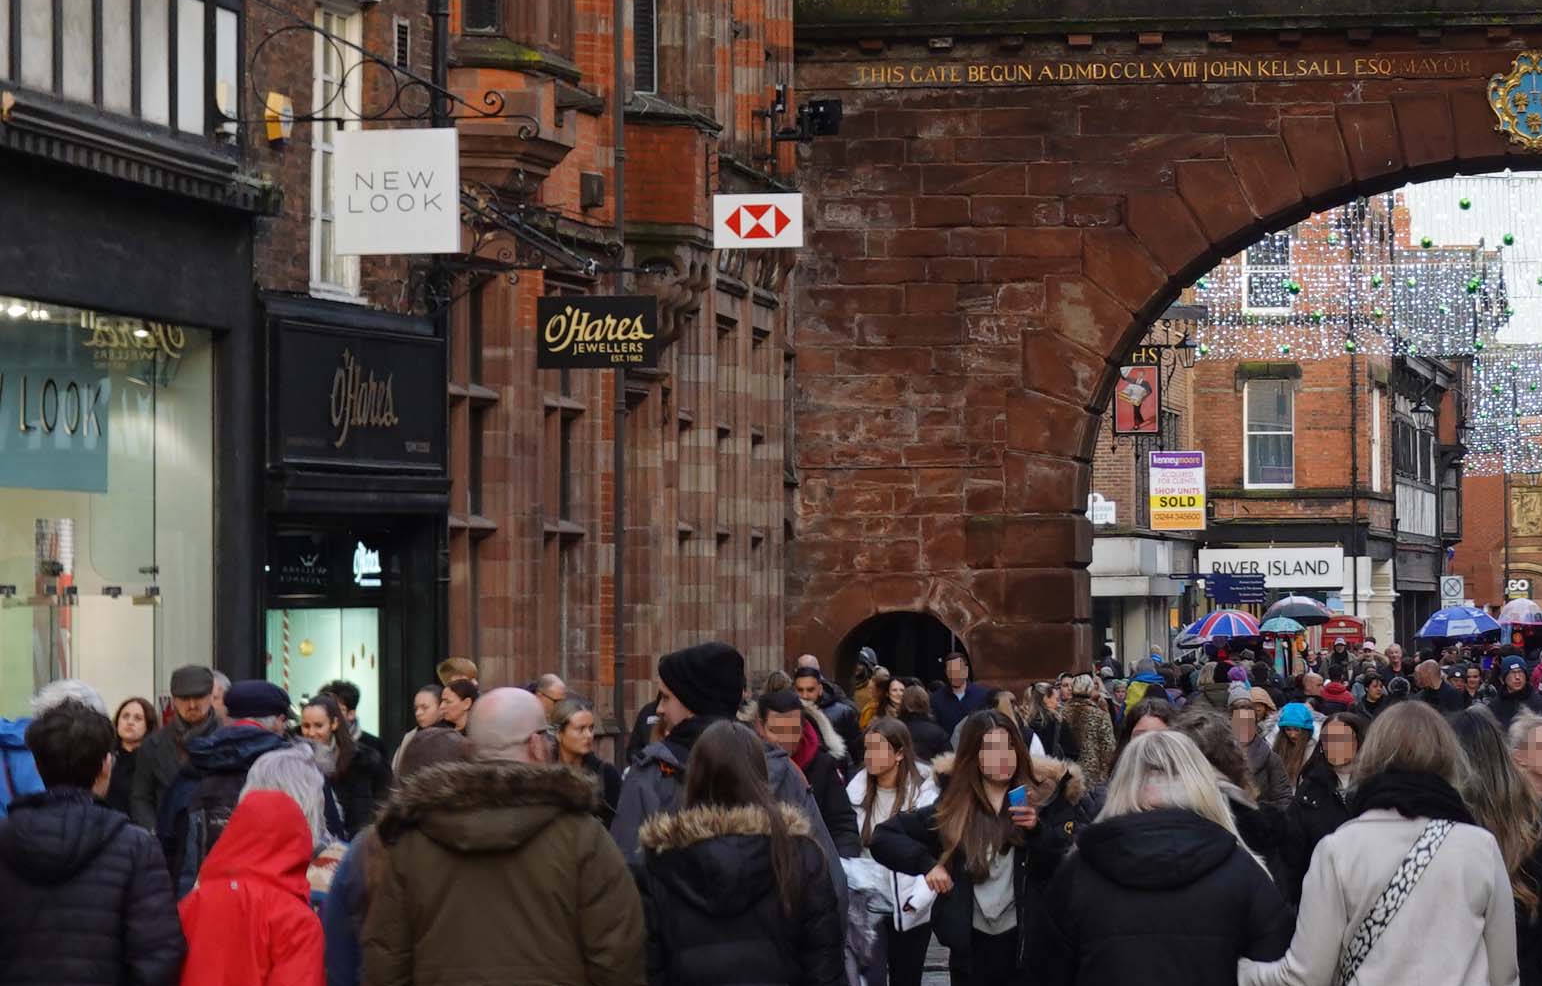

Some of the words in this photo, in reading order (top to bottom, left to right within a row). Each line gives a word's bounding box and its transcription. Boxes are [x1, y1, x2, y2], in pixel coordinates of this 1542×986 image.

[857, 65, 905, 84] THIS
[910, 64, 962, 83] GATE
[967, 64, 1032, 83] BEGUN
[1202, 60, 1252, 82] JOHN
[1257, 59, 1348, 78] KELSALL
[355, 171, 435, 191] NEW
[348, 192, 443, 214] LOOK
[545, 305, 655, 353] O'Hares
[572, 341, 644, 356] JEWELLERS
[19, 373, 103, 439] LOOK
[1159, 496, 1196, 508] SOLD
[1212, 561, 1260, 574] RIVER
[1268, 560, 1330, 576] ISLAND
[1508, 579, 1529, 591] GO
